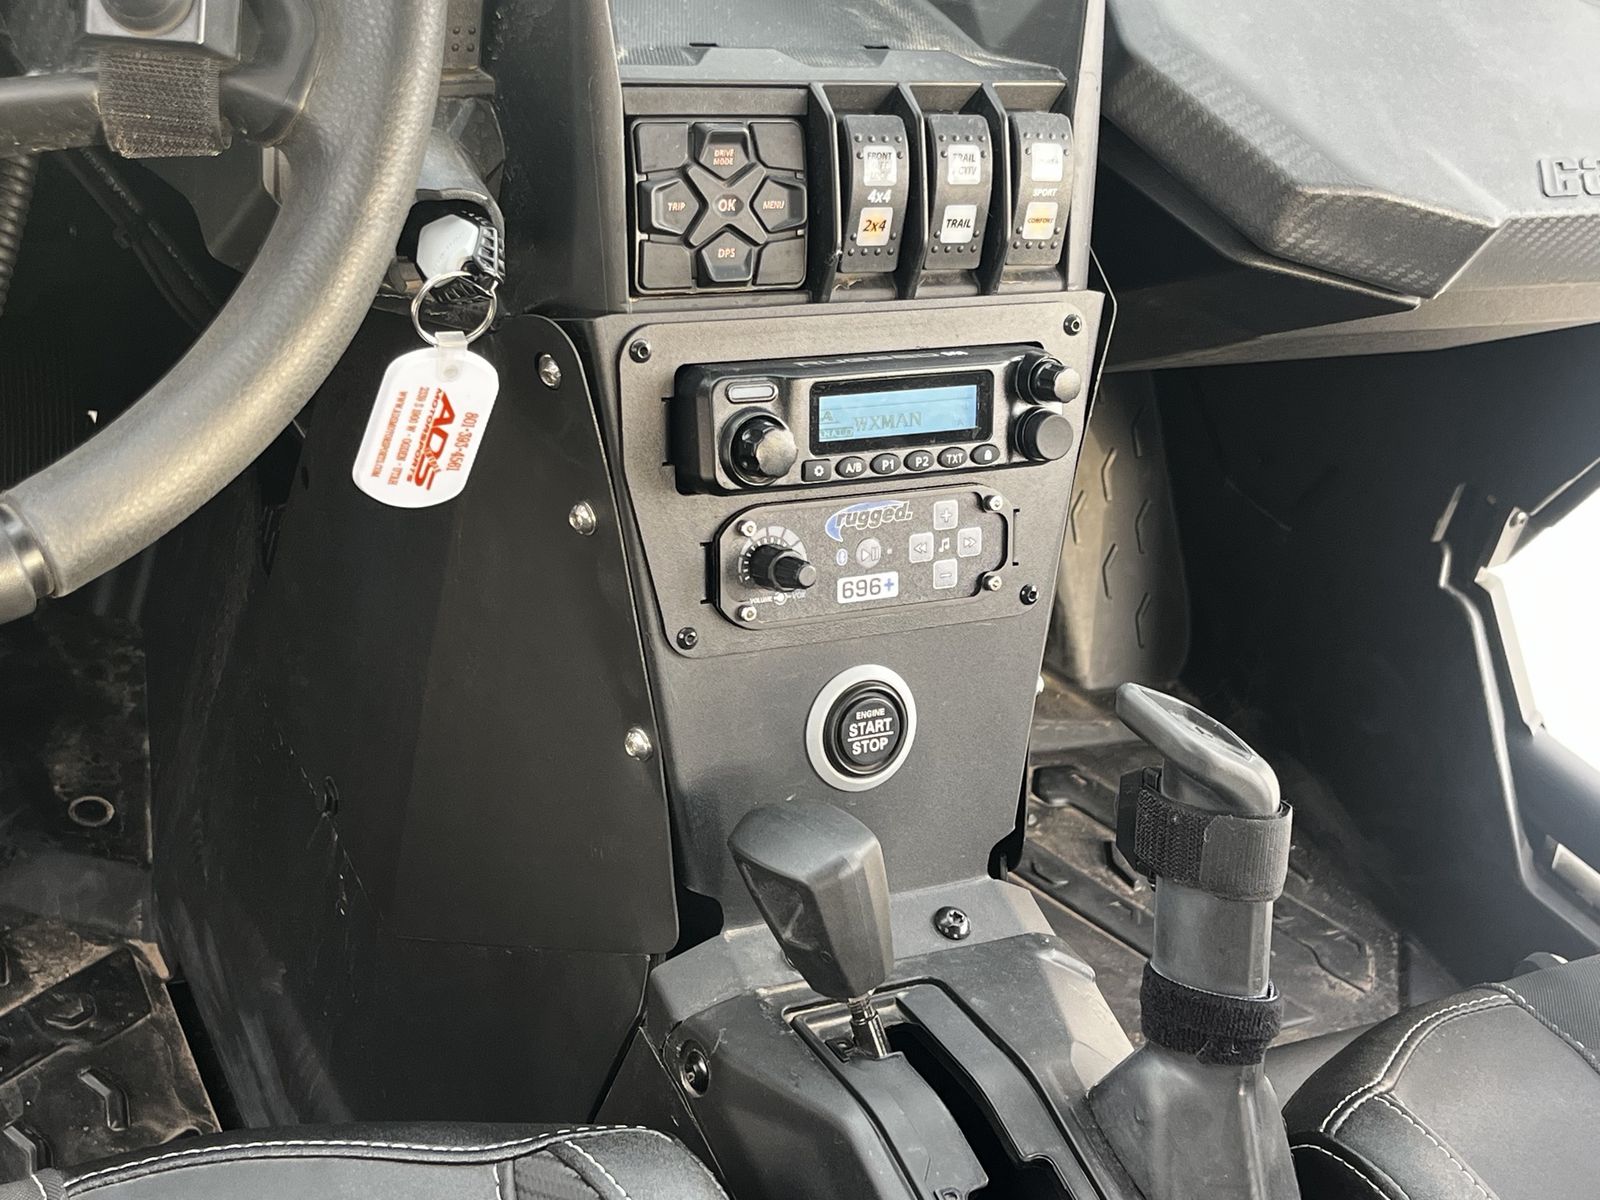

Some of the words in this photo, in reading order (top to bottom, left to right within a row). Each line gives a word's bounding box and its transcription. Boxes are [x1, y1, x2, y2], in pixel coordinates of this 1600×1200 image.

[714, 148, 734, 157] DRIVE
[867, 152, 892, 160] FRONT
[713, 157, 734, 166] MODE
[867, 189, 892, 204] 4x4
[1032, 188, 1058, 197] SPORT
[667, 202, 686, 212] TRIP
[718, 198, 737, 212] OK
[763, 200, 786, 210] MENU
[863, 219, 887, 233] 2x4
[946, 218, 972, 229] TRAIL
[717, 248, 736, 258] DPS
[853, 411, 923, 432] WXMAN
[406, 387, 443, 482] MOTORSPORTS
[415, 392, 455, 490] ADS
[882, 459, 895, 471] P1
[915, 456, 929, 468] P2
[945, 453, 963, 465] TXT
[845, 462, 862, 474] A/B
[855, 708, 886, 720] ENGINE
[848, 717, 893, 738] START
[852, 737, 889, 755] STOP
